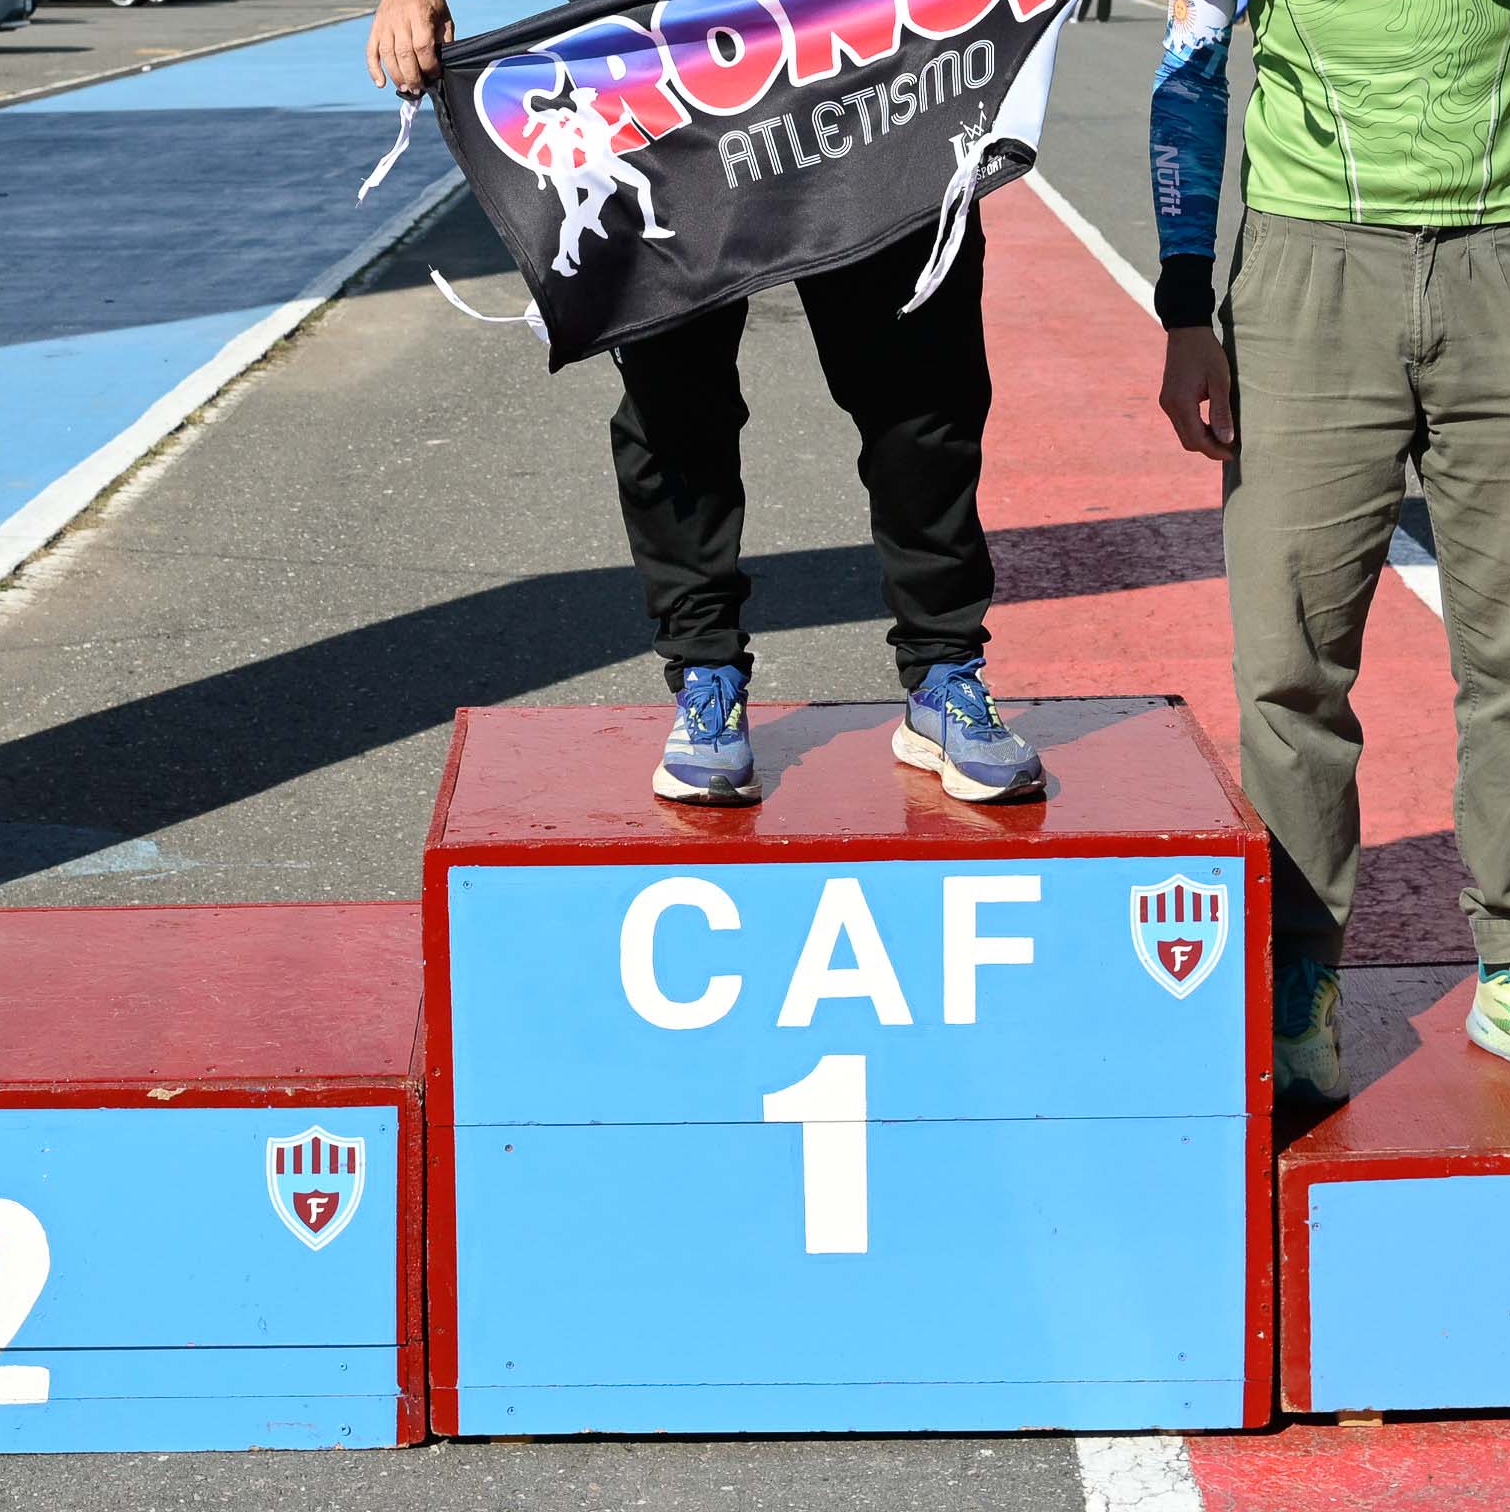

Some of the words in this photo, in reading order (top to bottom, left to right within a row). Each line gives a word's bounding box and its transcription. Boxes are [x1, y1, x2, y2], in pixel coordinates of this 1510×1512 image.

[719, 39, 996, 190] ATLETISMO
[619, 874, 1042, 1031] CAF
[762, 1054, 869, 1254] 1
